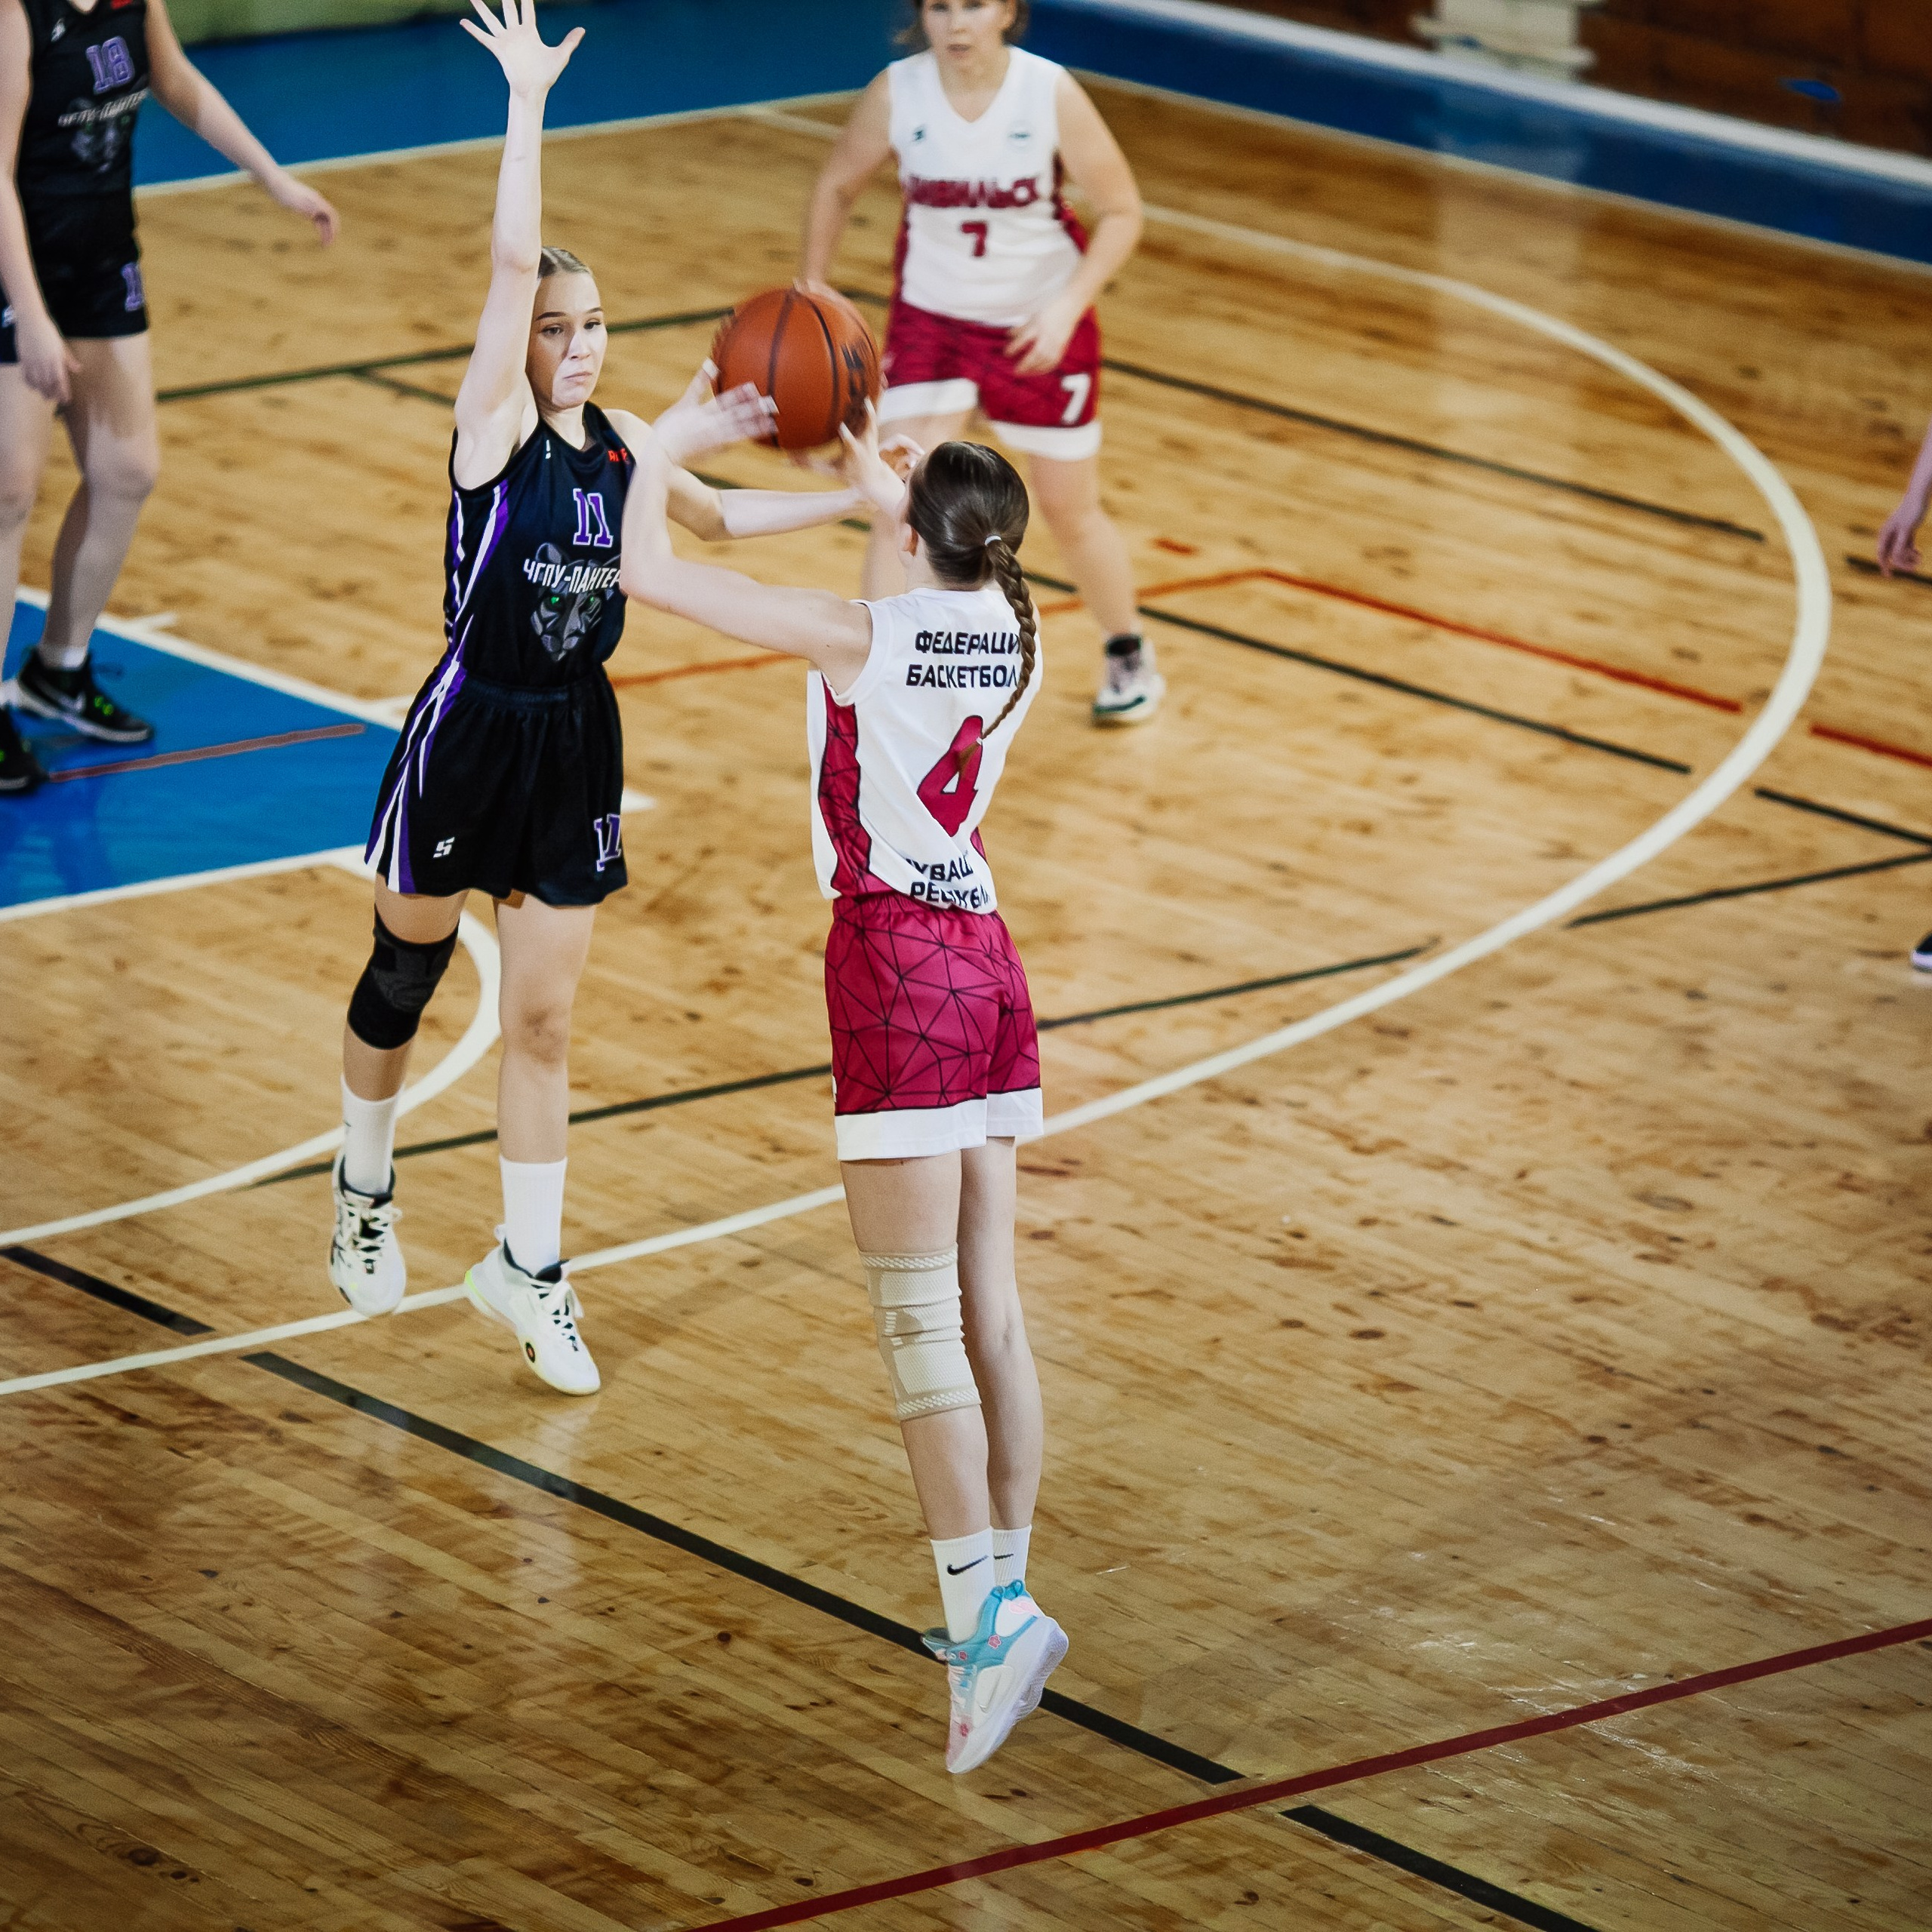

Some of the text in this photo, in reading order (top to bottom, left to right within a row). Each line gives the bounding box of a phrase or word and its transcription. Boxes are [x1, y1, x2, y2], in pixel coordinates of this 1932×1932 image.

[86, 36, 135, 94] 18
[961, 221, 987, 257] 7
[122, 263, 144, 312] 1
[1061, 373, 1091, 424] 7
[573, 488, 613, 547] 11
[915, 630, 1020, 654] ФЕДЕРАЦИ
[906, 664, 1018, 688] БАСКЕТБОЛ
[916, 715, 983, 838] 4
